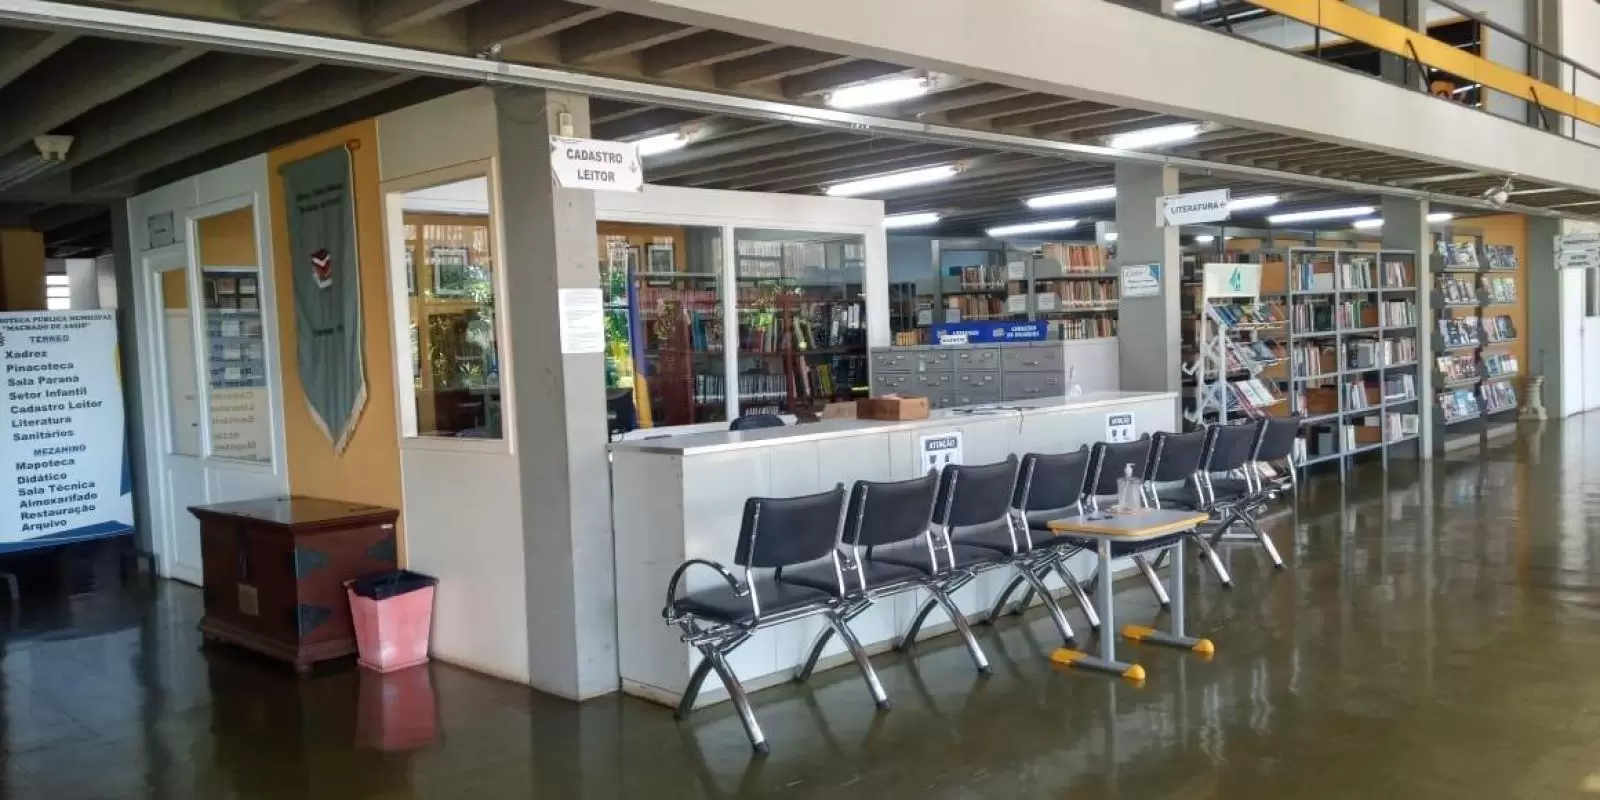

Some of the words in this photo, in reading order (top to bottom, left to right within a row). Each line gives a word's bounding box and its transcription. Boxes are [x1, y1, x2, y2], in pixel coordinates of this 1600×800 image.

[566, 148, 623, 164] CADASTRO
[577, 169, 616, 183] LEITOR
[1170, 202, 1219, 214] LITERATURA
[5, 350, 48, 359] Xadrez
[6, 361, 75, 373] Pinacoteca
[8, 377, 34, 387] Sala
[9, 391, 42, 401] Setor
[45, 387, 88, 398] Infantil
[10, 403, 65, 414] Cadastro
[68, 399, 103, 409] Leitor
[11, 416, 72, 428] Literatura
[13, 429, 75, 441] Sanitários
[15, 458, 76, 471] Mapoteca
[17, 472, 68, 484] Didático
[18, 486, 45, 496] Sala
[48, 480, 96, 493] Técnica
[20, 492, 98, 508] Almoxarifado
[21, 504, 97, 520] Restauração
[21, 519, 68, 532] Arquivo
